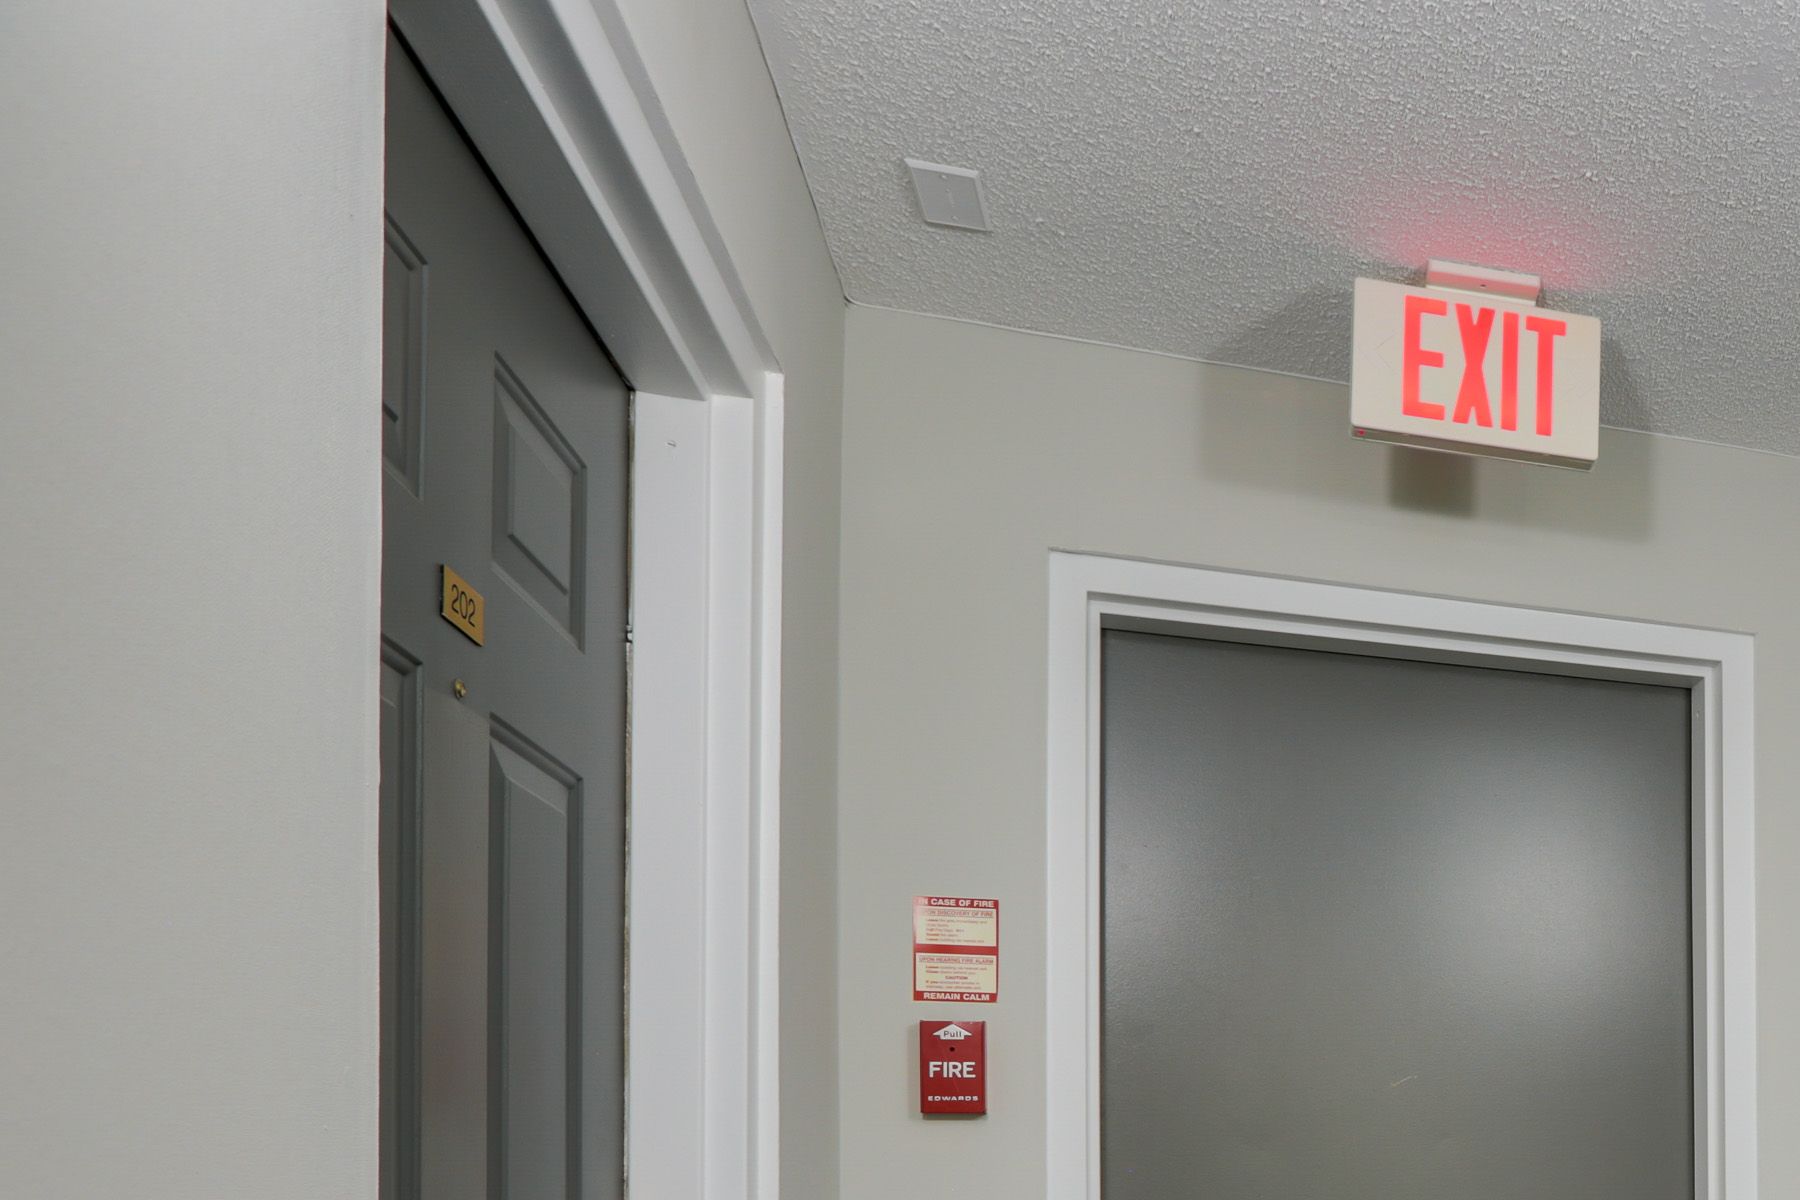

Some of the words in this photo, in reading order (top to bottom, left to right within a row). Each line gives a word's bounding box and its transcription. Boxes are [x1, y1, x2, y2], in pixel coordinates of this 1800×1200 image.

[1402, 294, 1567, 437] EXIT
[451, 583, 476, 628] 202
[930, 898, 956, 906] CASE
[958, 899, 972, 907] OF
[973, 900, 995, 908] FIRE
[923, 992, 961, 1000] REMAIN
[962, 993, 990, 1001] CALM
[943, 1030, 962, 1038] Pull
[928, 1061, 976, 1078] FIRE
